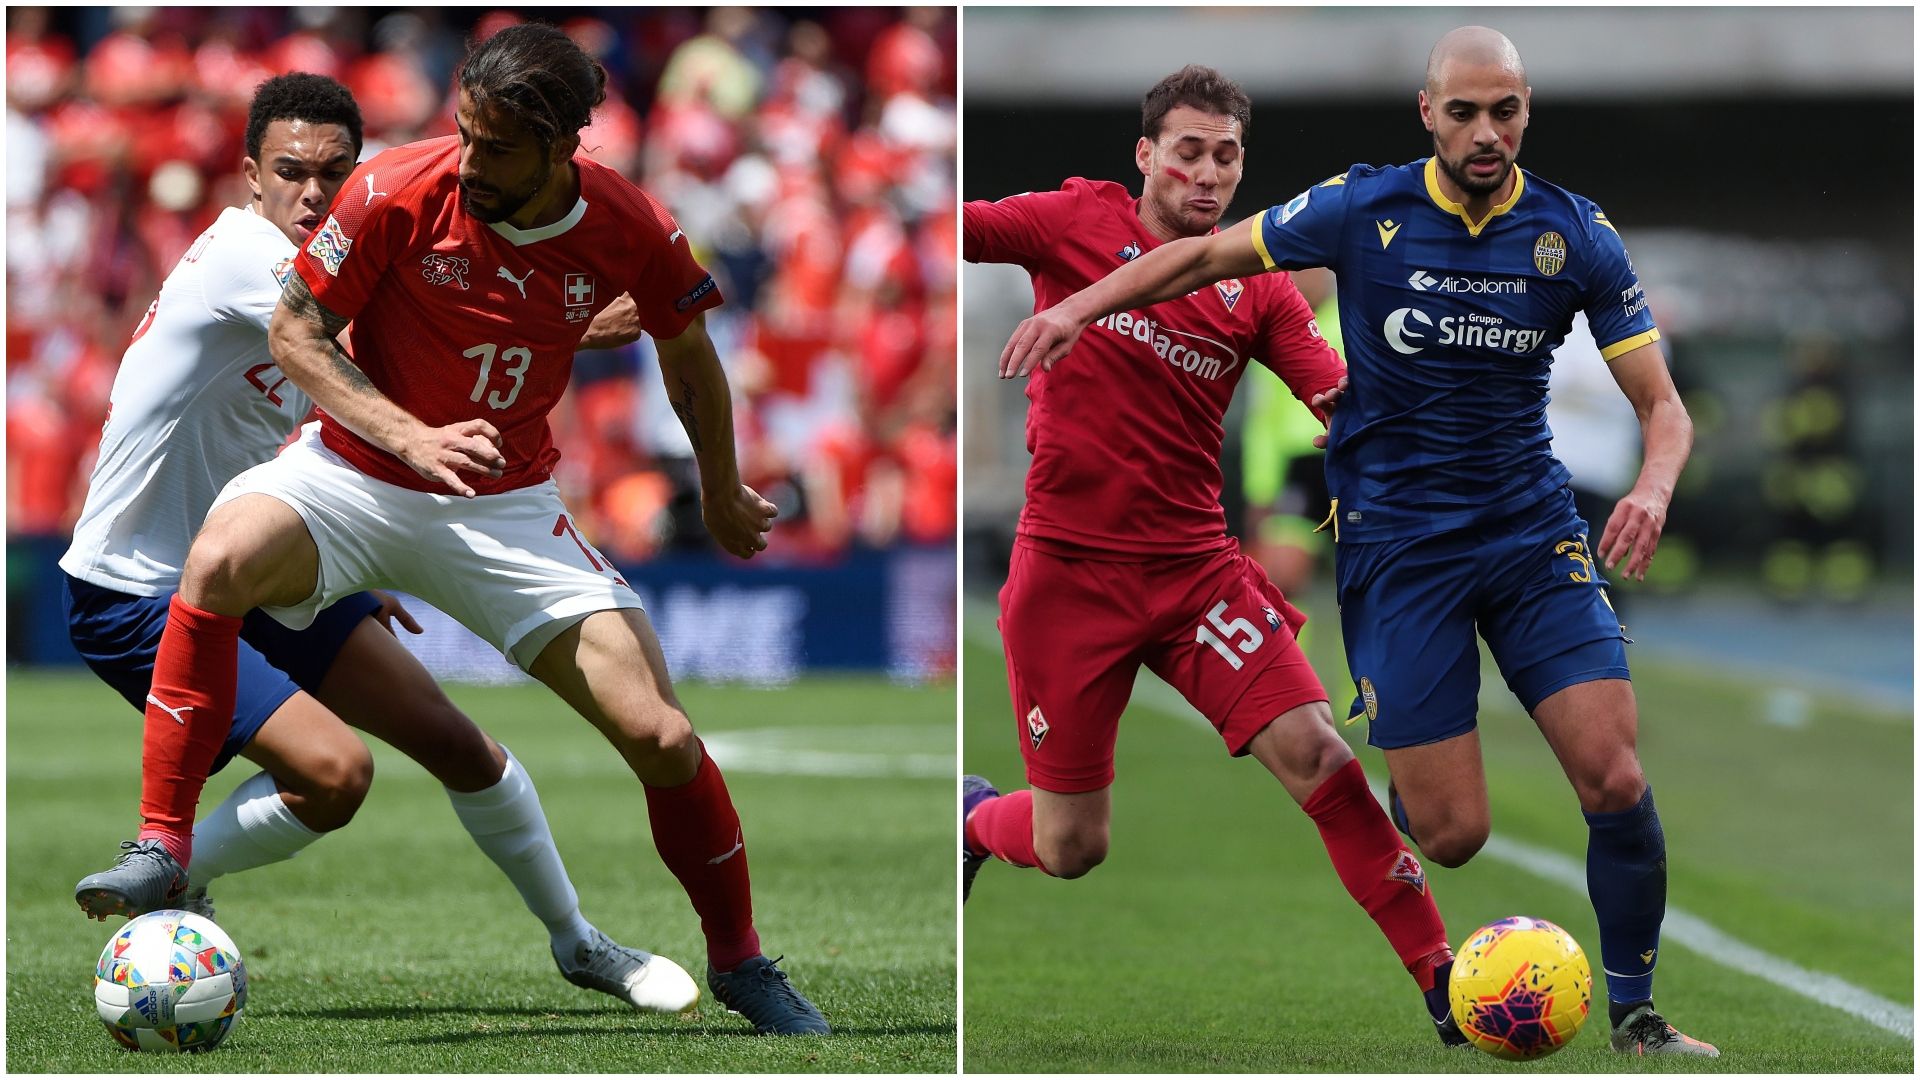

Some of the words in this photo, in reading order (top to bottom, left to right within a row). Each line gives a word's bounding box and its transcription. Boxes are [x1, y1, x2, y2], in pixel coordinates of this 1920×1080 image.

[1438, 277, 1527, 294] AirDolomiti
[1438, 316, 1547, 354] Sinergy
[1468, 313, 1503, 326] Gruppo
[463, 343, 532, 410] 13
[1195, 599, 1264, 671] 15
[150, 990, 159, 1026] adidas
